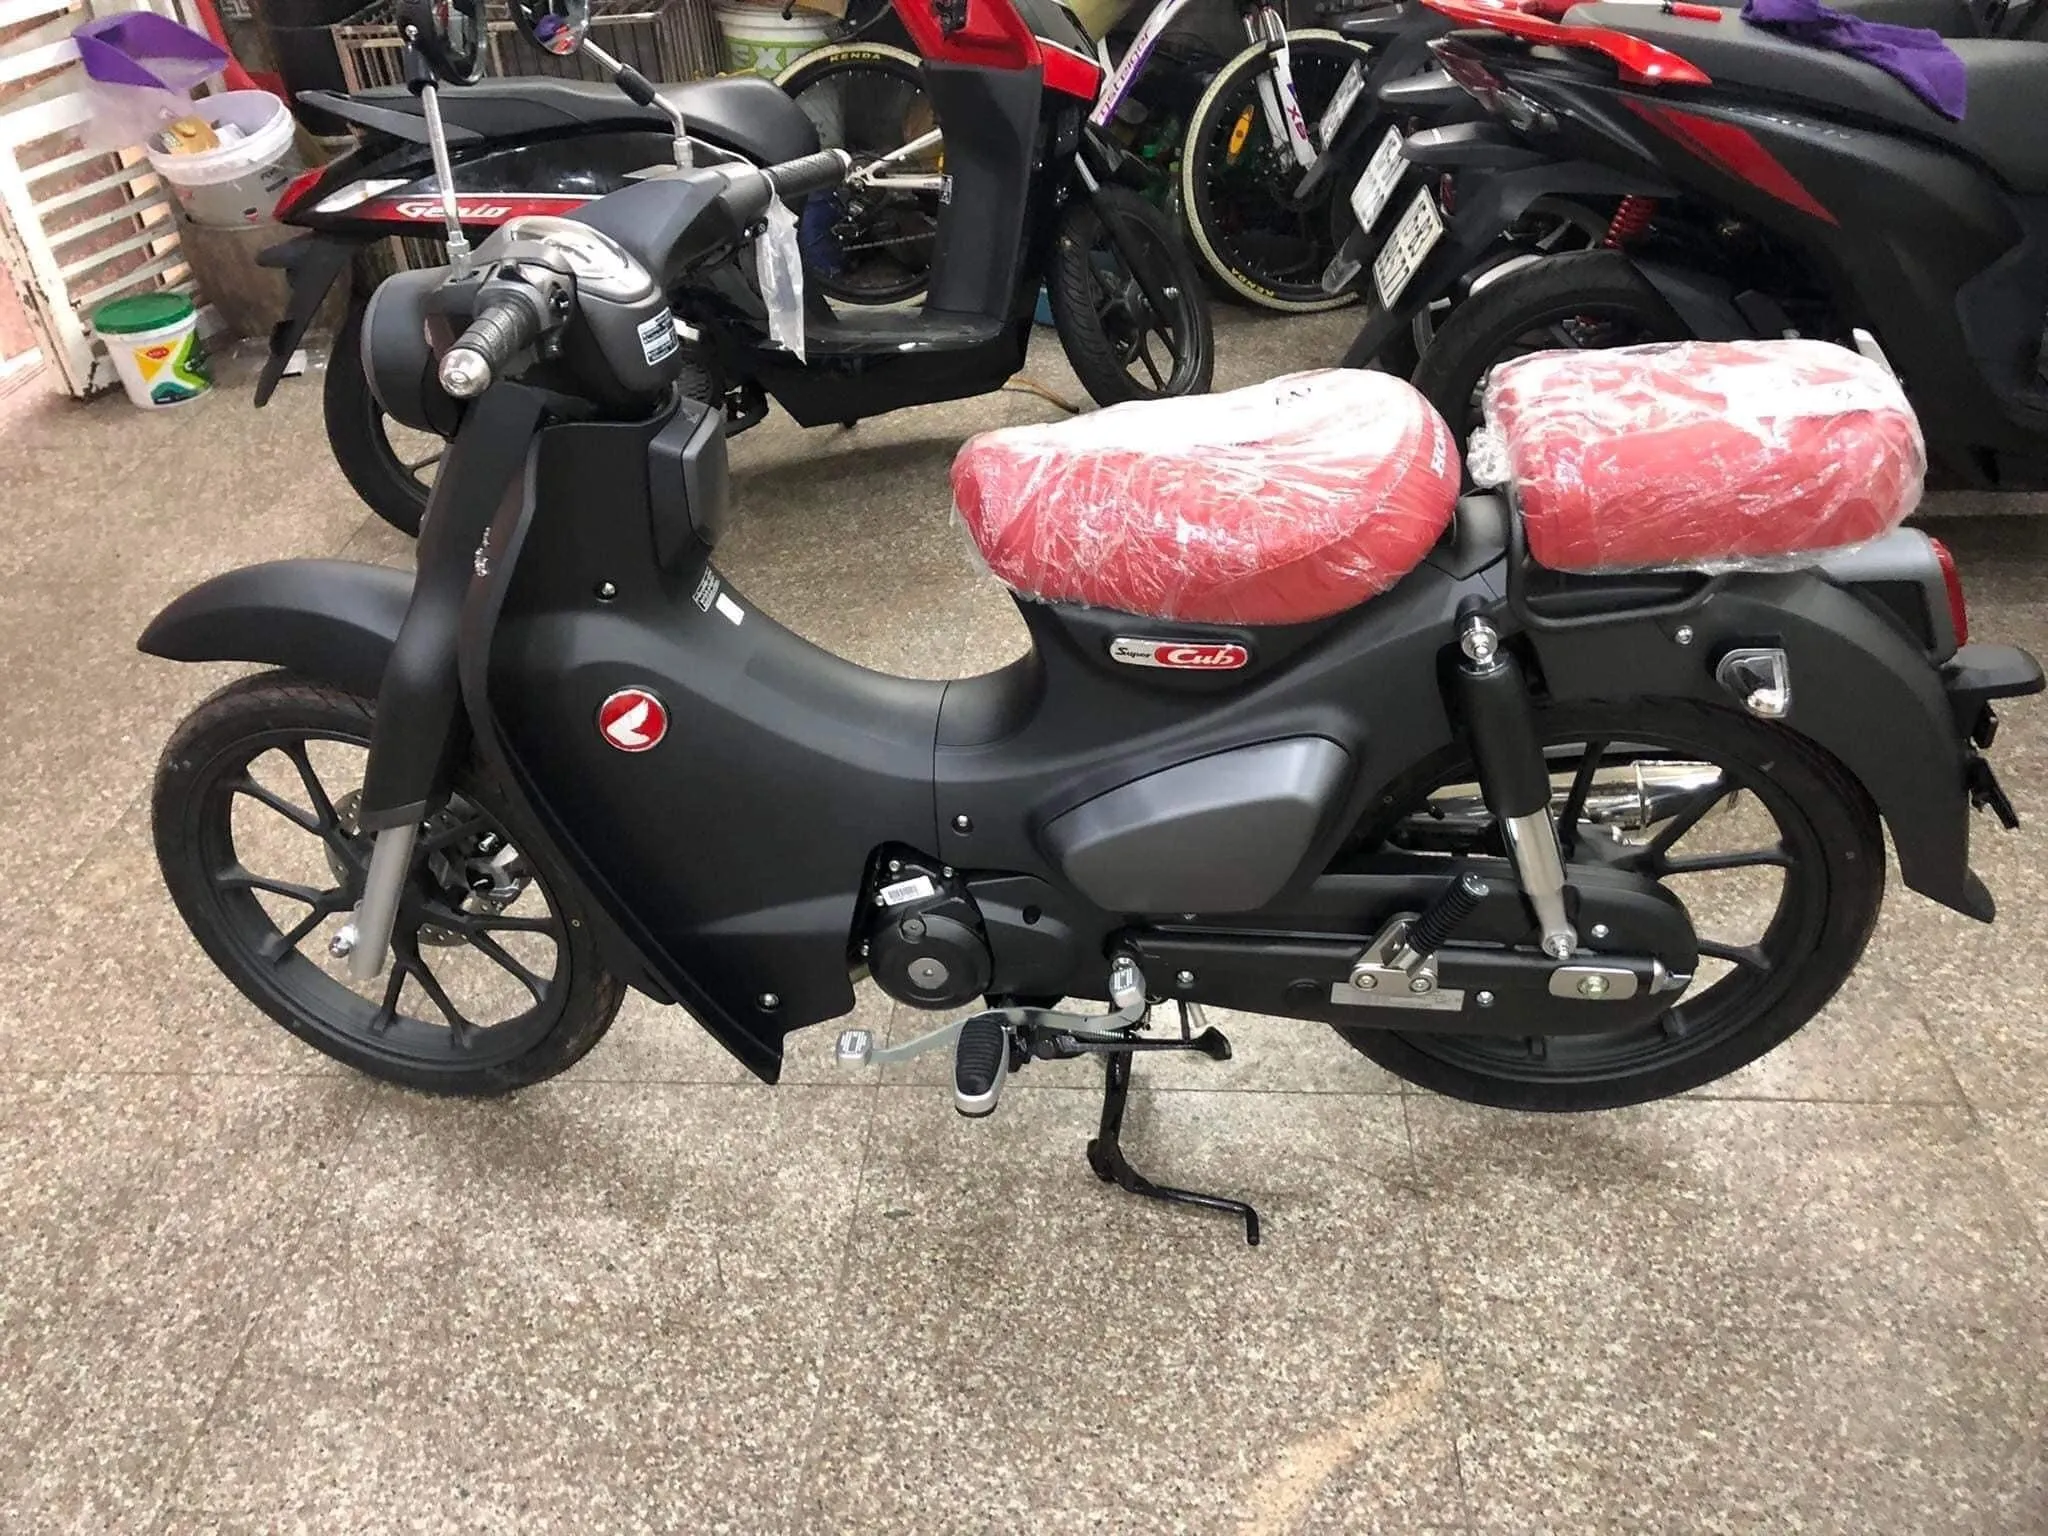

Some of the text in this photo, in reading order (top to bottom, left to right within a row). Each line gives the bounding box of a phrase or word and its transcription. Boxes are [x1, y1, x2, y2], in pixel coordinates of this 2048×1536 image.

[829, 52, 881, 63] KENDA
[1115, 646, 1235, 665] Super Cub
